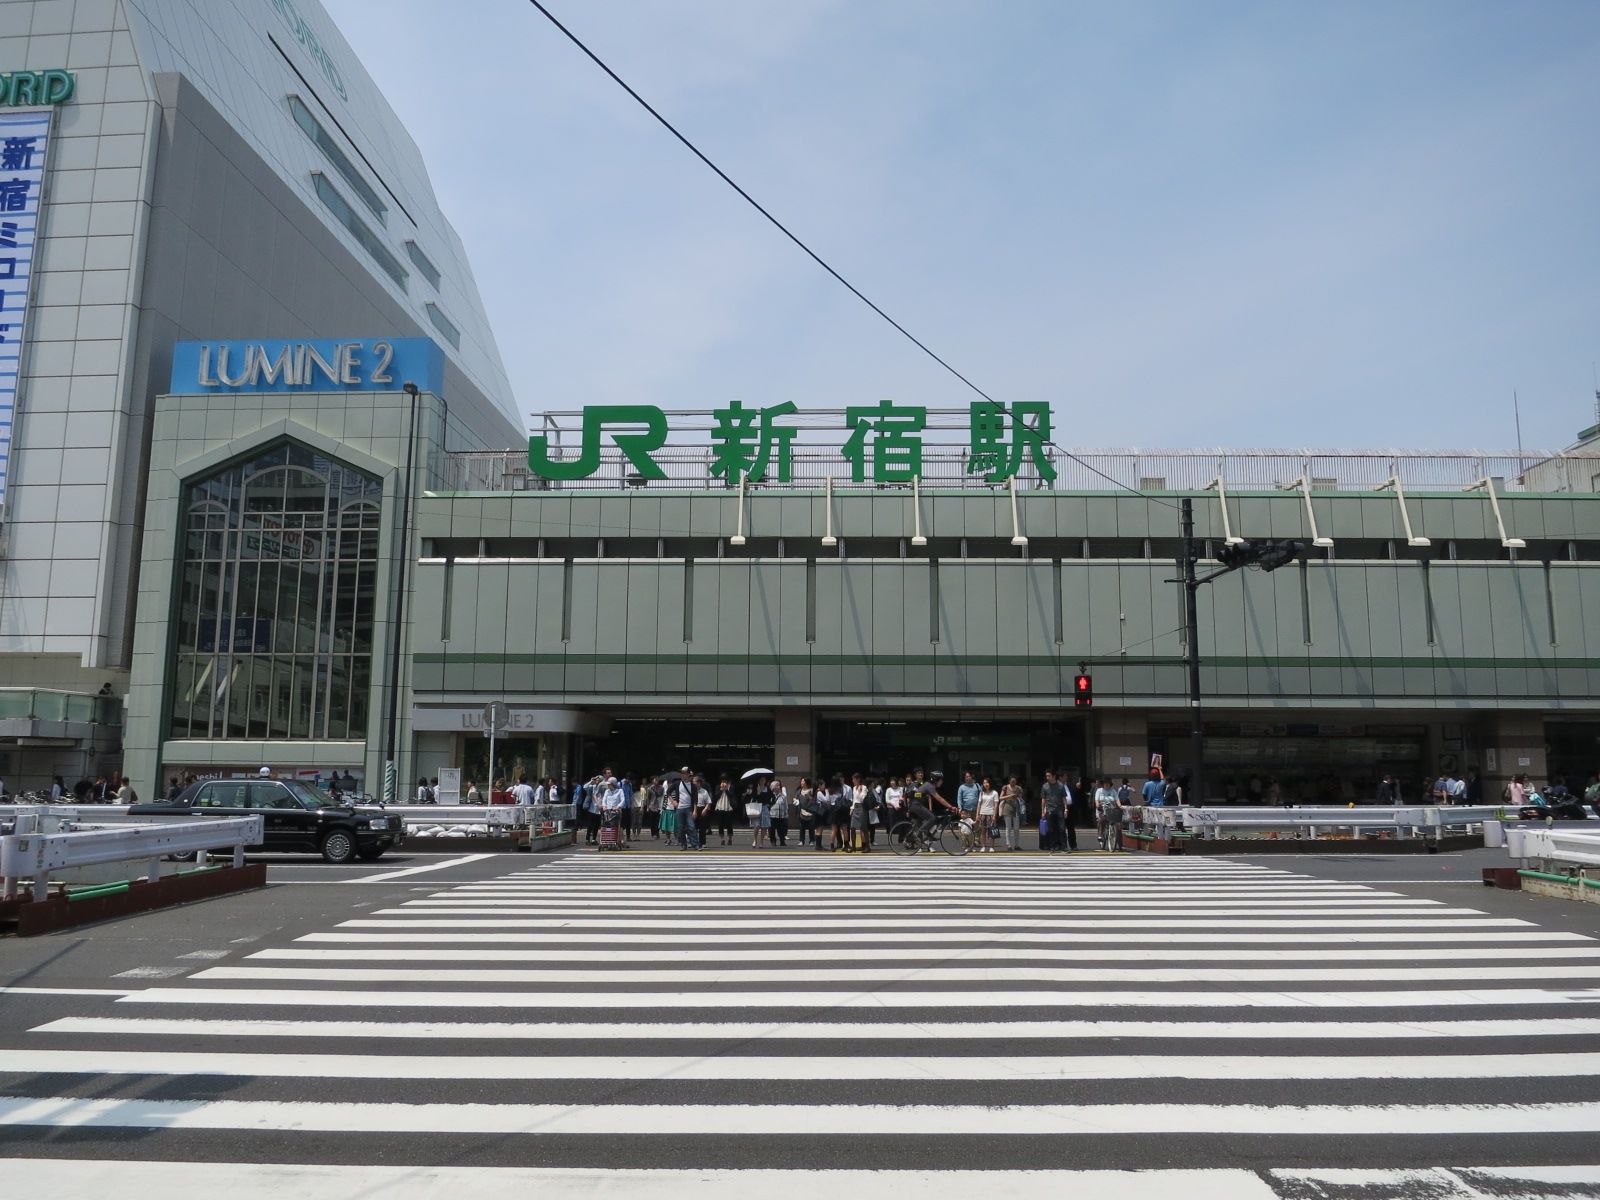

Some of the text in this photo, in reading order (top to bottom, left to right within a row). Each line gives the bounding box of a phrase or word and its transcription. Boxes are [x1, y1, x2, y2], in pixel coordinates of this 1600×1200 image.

[199, 340, 393, 386] LUMINE 2
[525, 713, 534, 728] 2
